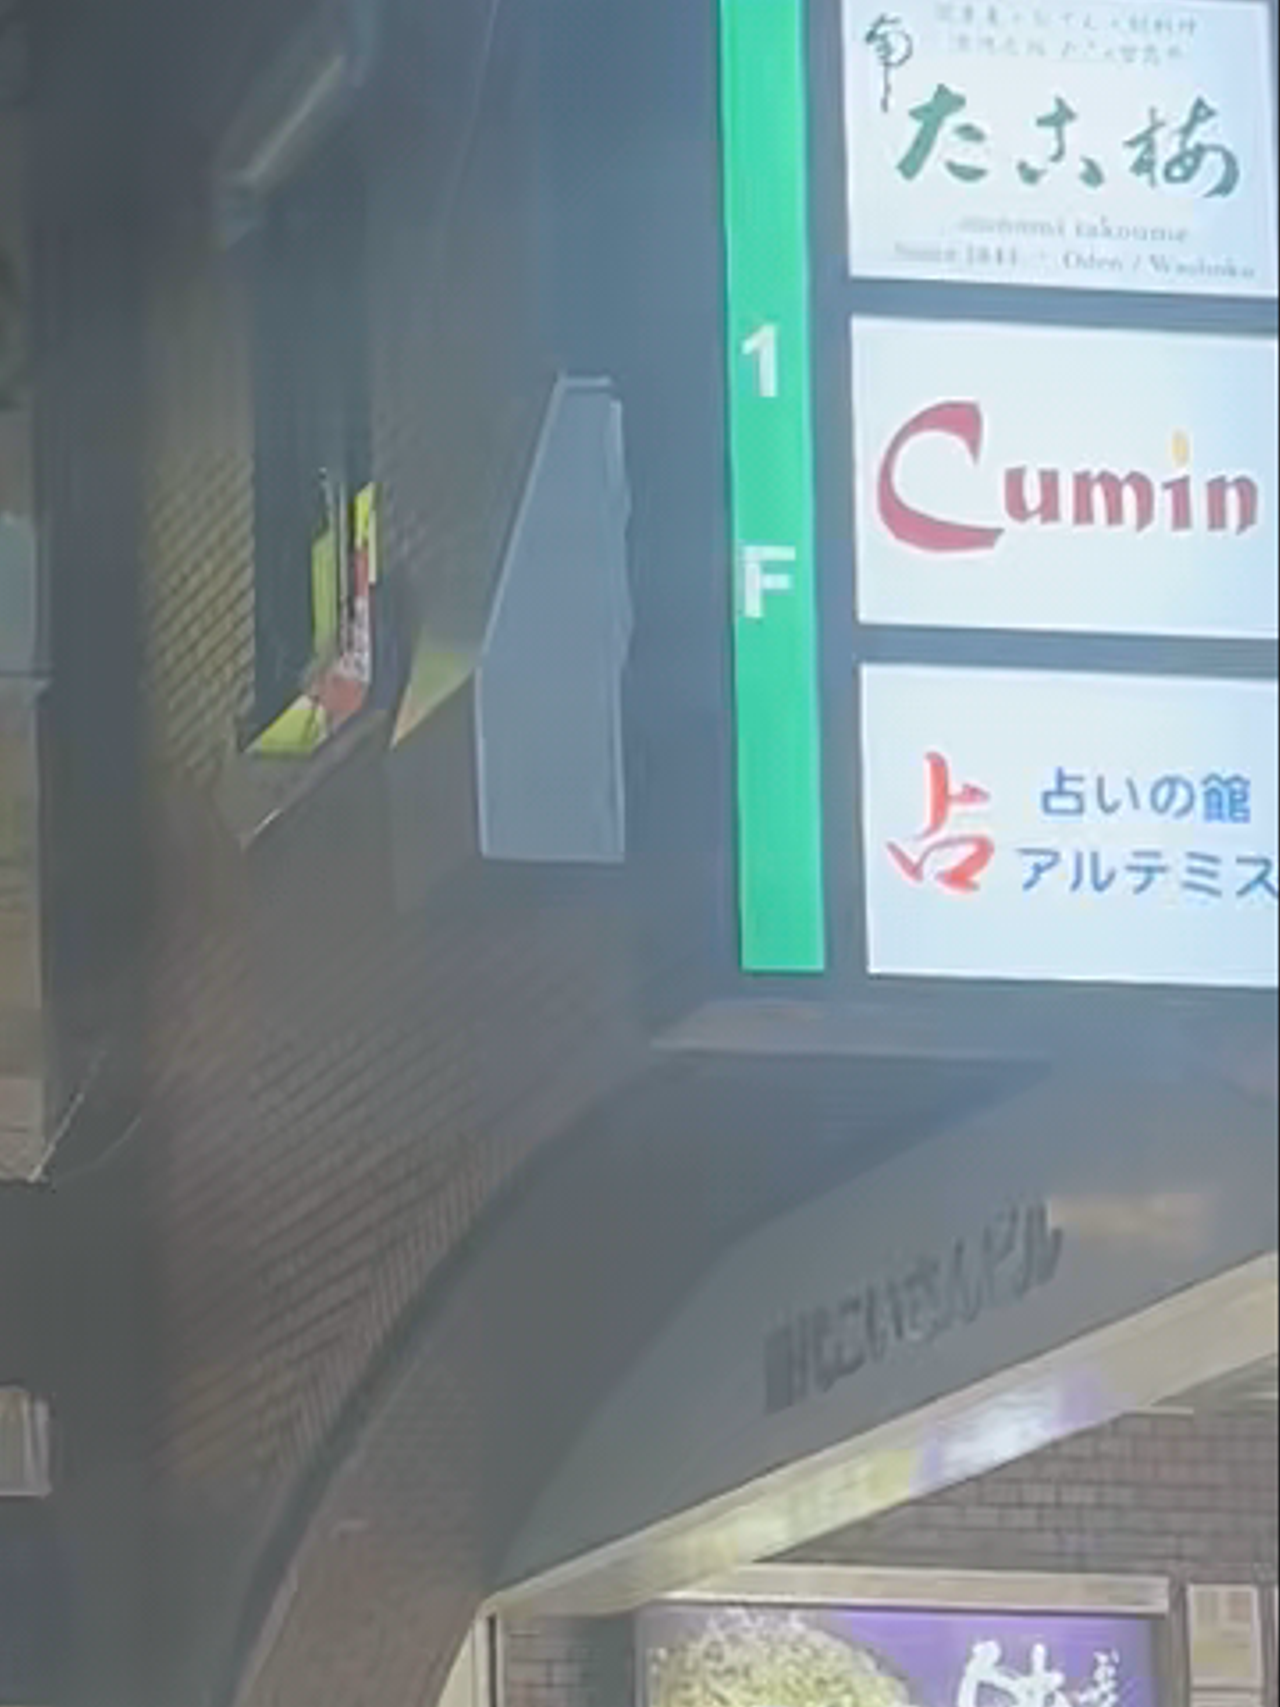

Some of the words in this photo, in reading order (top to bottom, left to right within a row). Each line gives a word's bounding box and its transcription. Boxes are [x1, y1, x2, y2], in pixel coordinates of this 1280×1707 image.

[896, 82, 1240, 199] たこ梅
[877, 399, 1258, 553] Cumin
[1039, 766, 1252, 824] 占いの館
[1015, 845, 1278, 899] アルテミス
